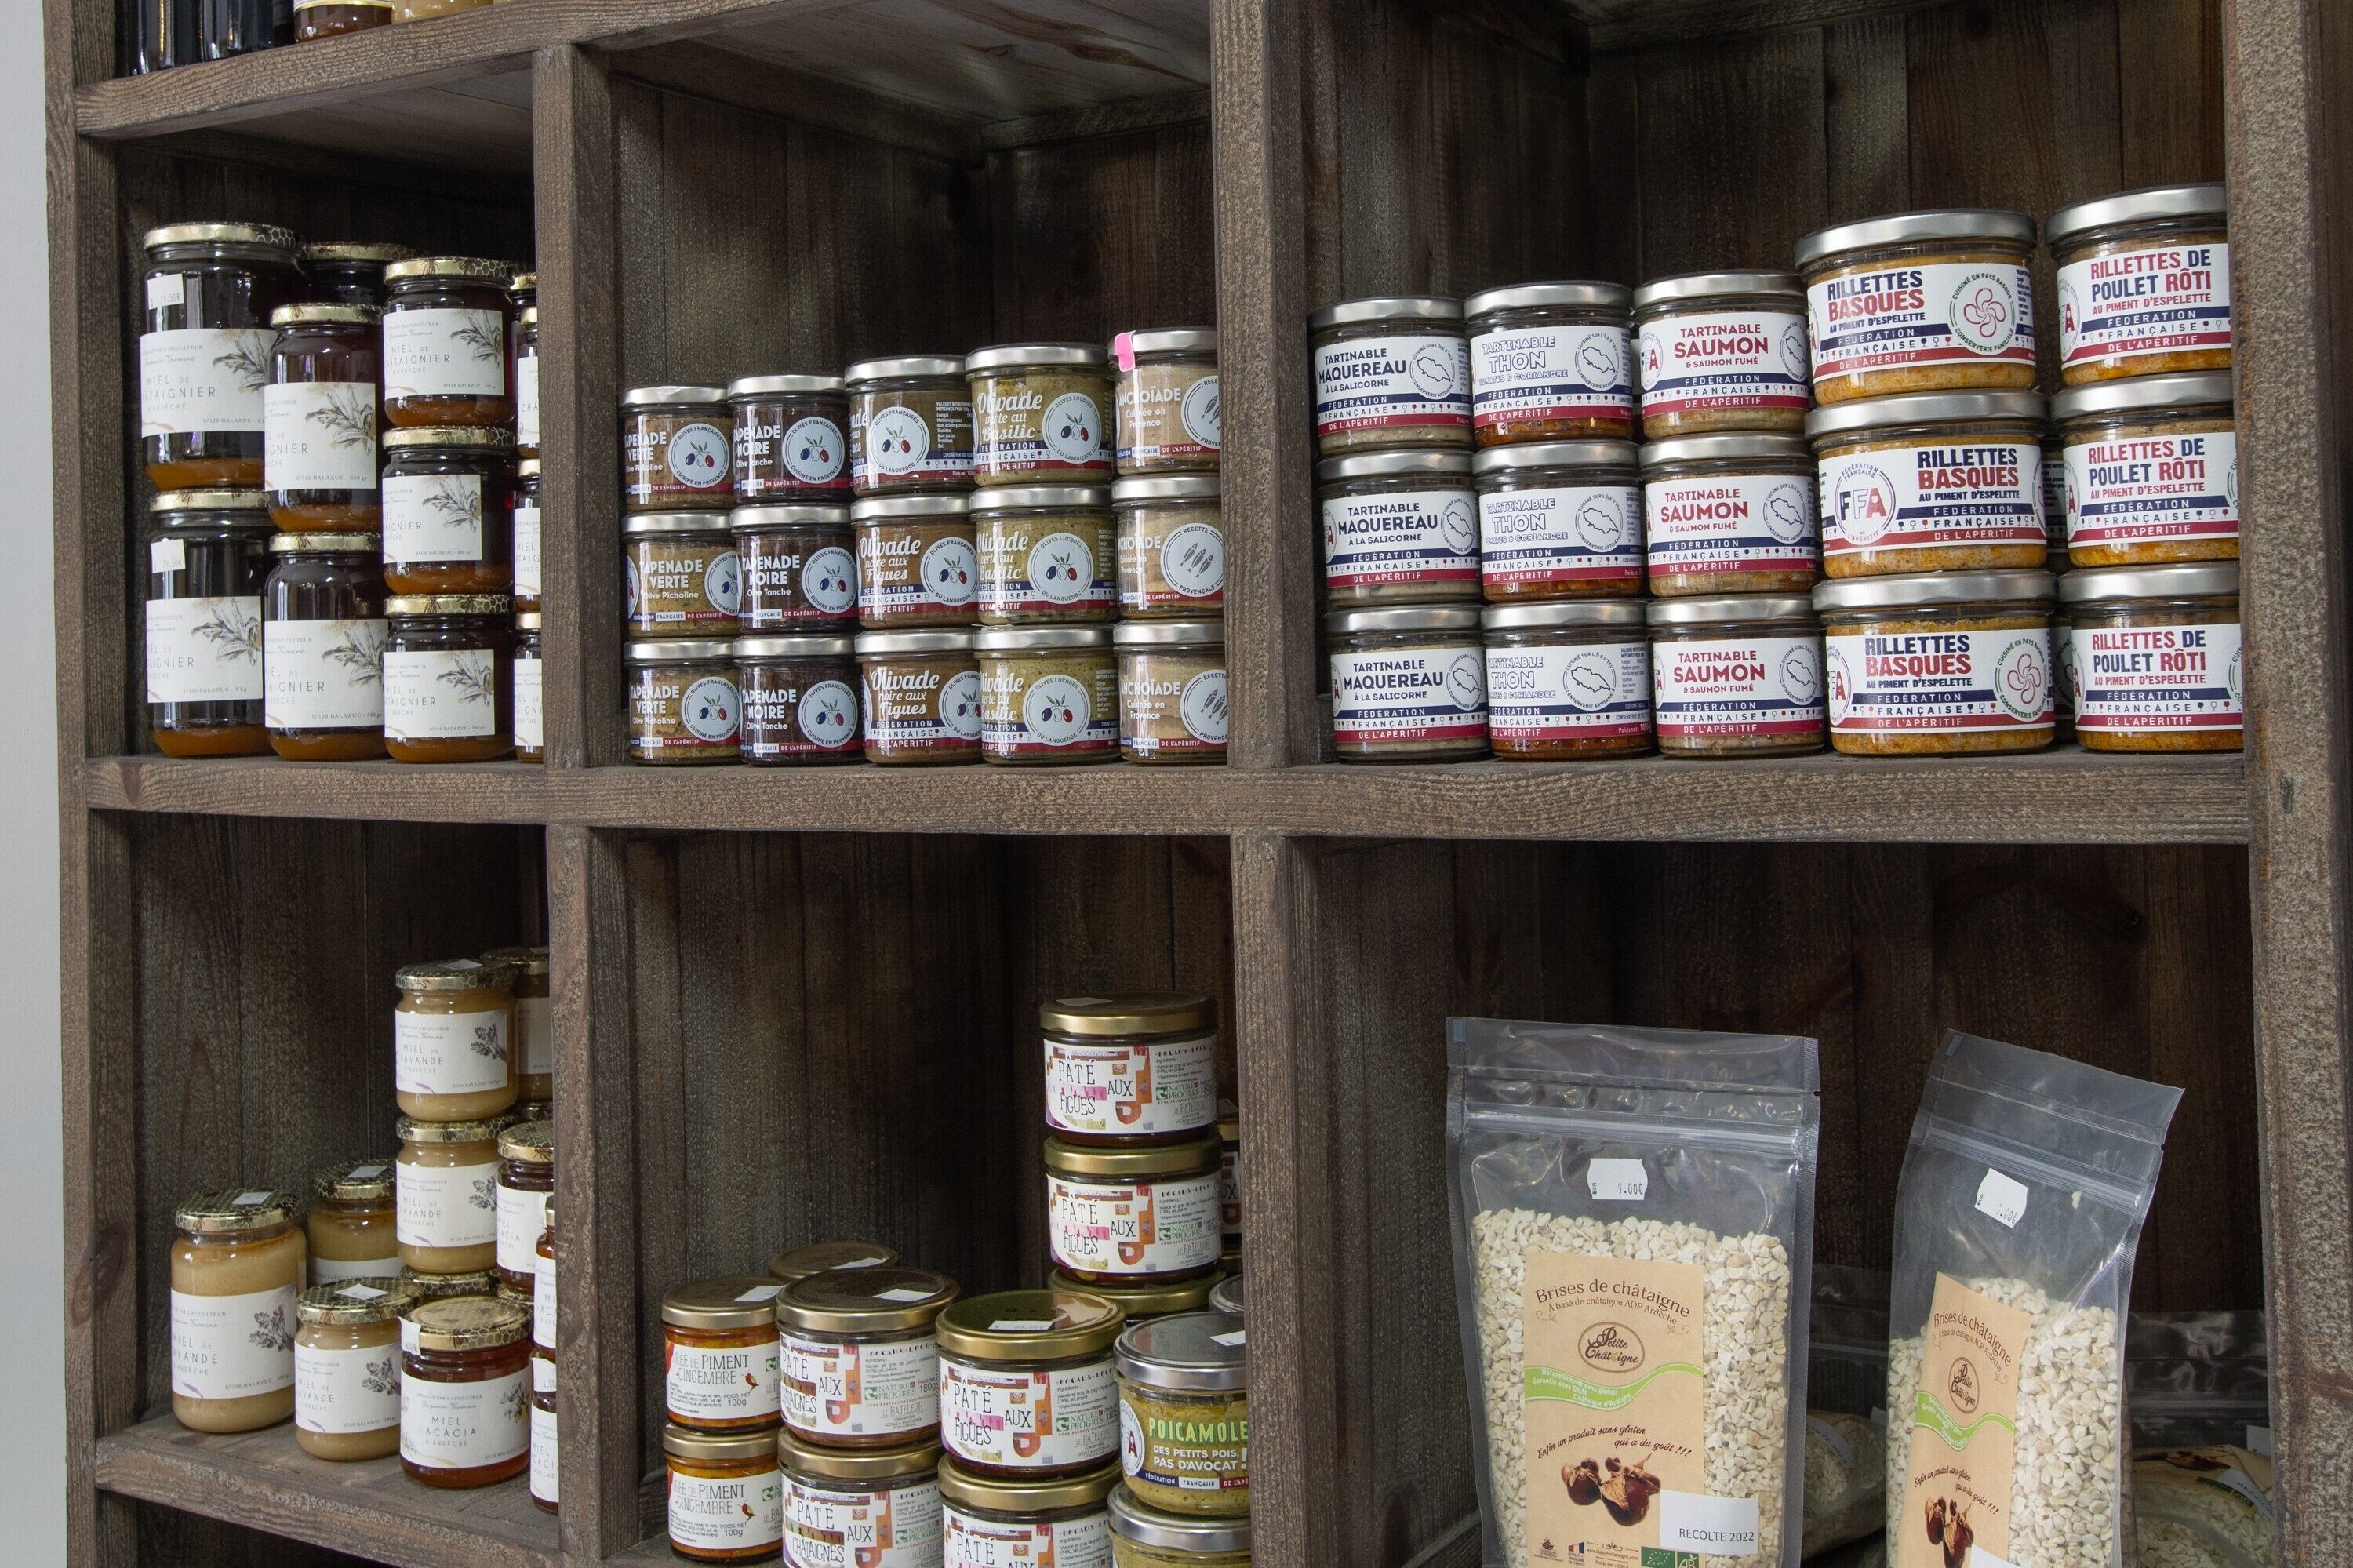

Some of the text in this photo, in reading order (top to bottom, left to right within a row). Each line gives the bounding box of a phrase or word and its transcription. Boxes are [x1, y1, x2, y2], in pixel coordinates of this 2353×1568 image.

[2091, 249, 2211, 280] RILLETTES DE
[1827, 270, 1922, 300] RILLETTES
[1952, 275, 1972, 300] CUISINÉ
[1981, 273, 1996, 282] PAYS
[2092, 269, 2211, 302] POULET RÔTI
[1828, 289, 1925, 322] BASQUES
[2093, 293, 2211, 315] AU PIMENT D'ESPELETTE
[1680, 324, 1761, 338] TARTINABLE
[1482, 337, 1555, 354] TARTINABLE
[1674, 337, 1769, 359] SAUMON
[1325, 348, 1387, 364] TARTINABLE
[1488, 351, 1546, 374] THON
[1693, 358, 1733, 367] SAUMON
[1735, 356, 1758, 365] FUMÉ
[147, 375, 170, 384] MIEL
[1318, 360, 1406, 384] MAQUEREAU
[1514, 369, 1568, 381] CORIANDRE
[1326, 384, 1329, 394] À
[1340, 380, 1389, 391] SALICORNE
[1012, 413, 1027, 423] au
[1918, 448, 2017, 468] RILLETTES
[2089, 438, 2205, 464] RILLETTES DE
[1918, 467, 2019, 490] BASQUES
[2089, 457, 2205, 486] POULET RÔTI
[1665, 488, 1740, 502] TARTINABLE
[1919, 490, 2020, 502] AU PIMENT D'ESPELETTE
[1347, 503, 1420, 517] TARTINABLE
[1486, 498, 1556, 511] TARTINABLE
[1660, 501, 1748, 523] SAUMON
[1840, 487, 1887, 521] FFA
[1338, 515, 1438, 536] MAQUEREAU
[1492, 513, 1546, 533] THON
[889, 557, 908, 566] aux
[1353, 550, 1420, 562] FÉDÉRATION
[1353, 562, 1420, 573] FRANÇAISE
[649, 575, 689, 588] VERTE
[1367, 572, 1421, 581] L'APÉRITIF
[1179, 584, 1216, 595] PROVENÇALE
[1865, 635, 1969, 656] RILLETTES
[2092, 630, 2206, 650] RILLETTES DE
[1678, 650, 1757, 663] TARTINABLE
[2093, 648, 2206, 672] POULET RÔTI
[1353, 660, 1425, 672] TARTINABLE
[1674, 664, 1765, 683] SAUMON
[1866, 654, 1972, 677] BASQUES
[871, 670, 940, 691] Olivade
[1035, 676, 1078, 690] OLIVES LUCQUES
[1344, 671, 1443, 691] MAQUEREAU
[1491, 671, 1535, 689] THON
[906, 691, 926, 700] aux
[1355, 692, 1359, 701] À
[1373, 691, 1427, 700] SALICORNE
[636, 701, 666, 714] VERTE
[747, 706, 784, 719] NOIRE
[879, 704, 926, 719] Figues
[1683, 701, 1756, 711] FÉDÉRATION
[1683, 711, 1757, 722] FRANÇAISE
[1700, 722, 1757, 733] L'APÉRITIF
[1046, 733, 1078, 743] LANGUEDOC
[403, 1045, 424, 1053] MIEL
[1059, 1056, 1095, 1085] PÂTÉ
[1107, 1080, 1133, 1096] AUX
[1060, 1093, 1096, 1115] FIGUES
[1618, 1182, 1643, 1195] 9.00€
[403, 1196, 421, 1206] MIEL
[399, 1210, 441, 1218] LAVANDE
[1062, 1195, 1098, 1224] PÂTÉ
[1111, 1221, 1136, 1237] AUX
[1064, 1231, 1098, 1255] FIGUES
[1535, 1279, 1690, 1318] Brises de châtaigne
[1556, 1299, 1573, 1309] base
[1576, 1297, 1584, 1306] de
[1587, 1296, 1623, 1308] châtaigne
[1624, 1301, 1643, 1311] AOP
[1644, 1305, 1678, 1326] Ardèche
[1934, 1310, 2010, 1366] Brises de châtaigne
[702, 1355, 748, 1369] PIMENT
[954, 1380, 991, 1413] PÂTÉ
[432, 1417, 461, 1426] MIEL
[1005, 1410, 1031, 1428] AUX
[955, 1417, 991, 1446] FIGUES
[1149, 1417, 1248, 1443] POICAMOLE
[1537, 1424, 1646, 1460] Enfin un produit sans gluten
[1614, 1439, 1629, 1448] qui
[1640, 1438, 1650, 1447] du
[1652, 1442, 1675, 1453] goût
[1153, 1445, 1169, 1455] DES
[1173, 1449, 1208, 1458] PETITS
[1154, 1456, 1174, 1468] PAS
[1179, 1461, 1238, 1471] D'AVOCAT
[1145, 1472, 1176, 1484] FÉDÉRATION
[798, 1497, 835, 1530] PÂTÉ
[847, 1526, 874, 1542] AUX
[1679, 1528, 1755, 1542] RECOLTE 2022
[956, 1530, 995, 1565] PÂTÉ
